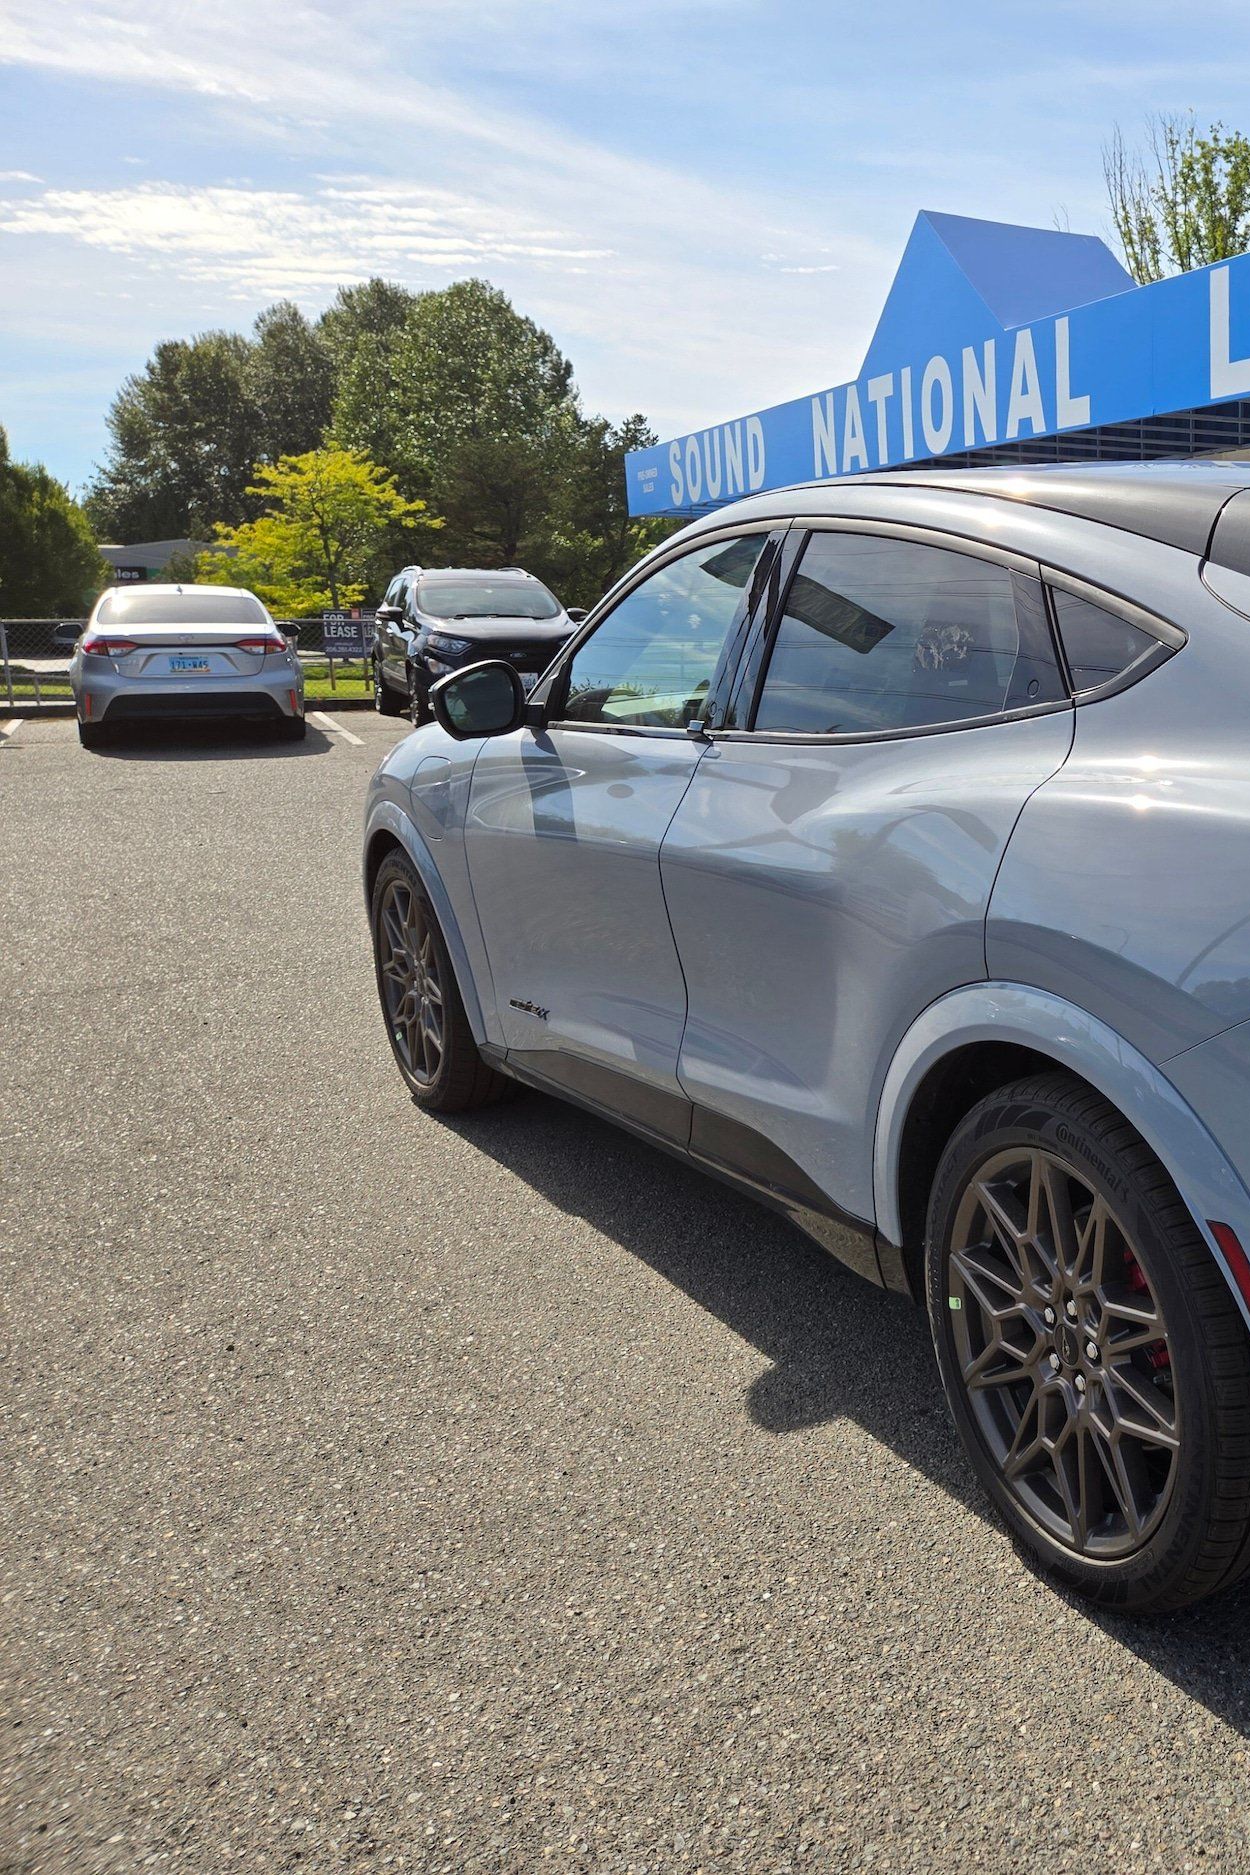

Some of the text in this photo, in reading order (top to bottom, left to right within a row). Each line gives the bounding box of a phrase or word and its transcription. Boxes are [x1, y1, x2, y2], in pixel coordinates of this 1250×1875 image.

[669, 415, 766, 506] SOUND
[812, 316, 1091, 478] NATIONAL
[323, 613, 345, 626] FOR
[324, 626, 359, 638] LEASE
